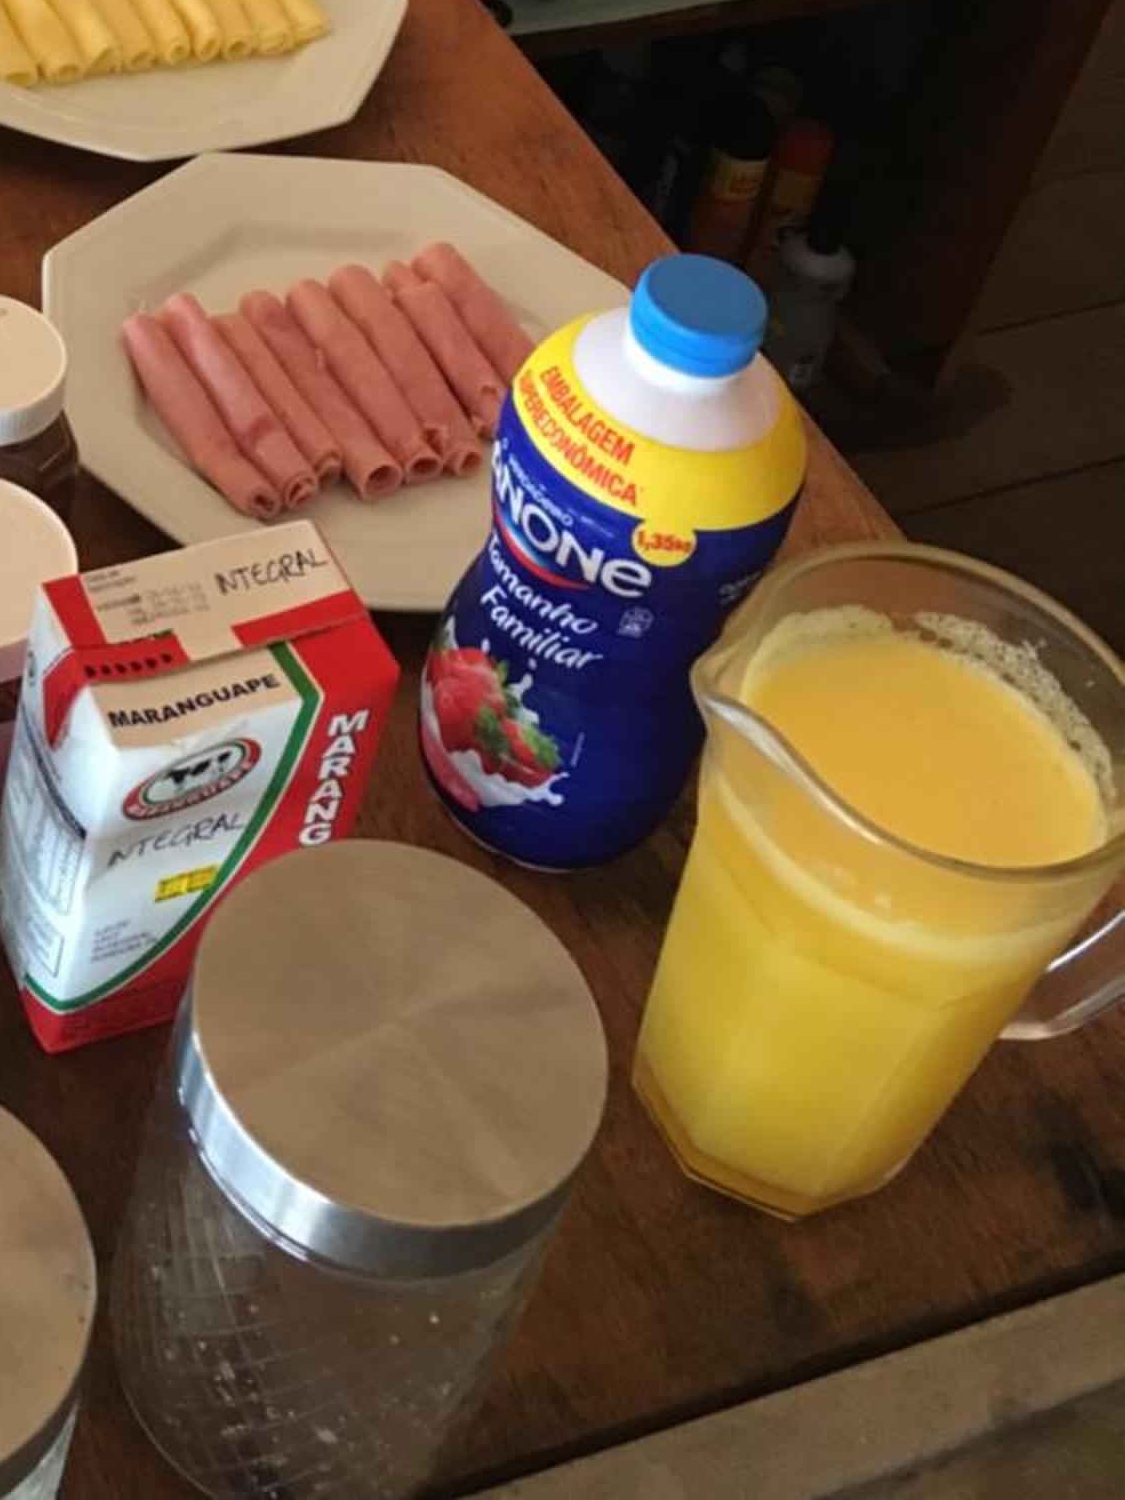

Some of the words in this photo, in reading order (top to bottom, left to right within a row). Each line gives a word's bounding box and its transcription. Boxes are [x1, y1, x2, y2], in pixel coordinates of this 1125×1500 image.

[540, 365, 635, 465] EMBALAGEM
[480, 584, 604, 670] Familiar
[488, 527, 598, 634] Tamanho
[107, 673, 280, 729] MARANGUAPE
[298, 708, 371, 846] MARANG
